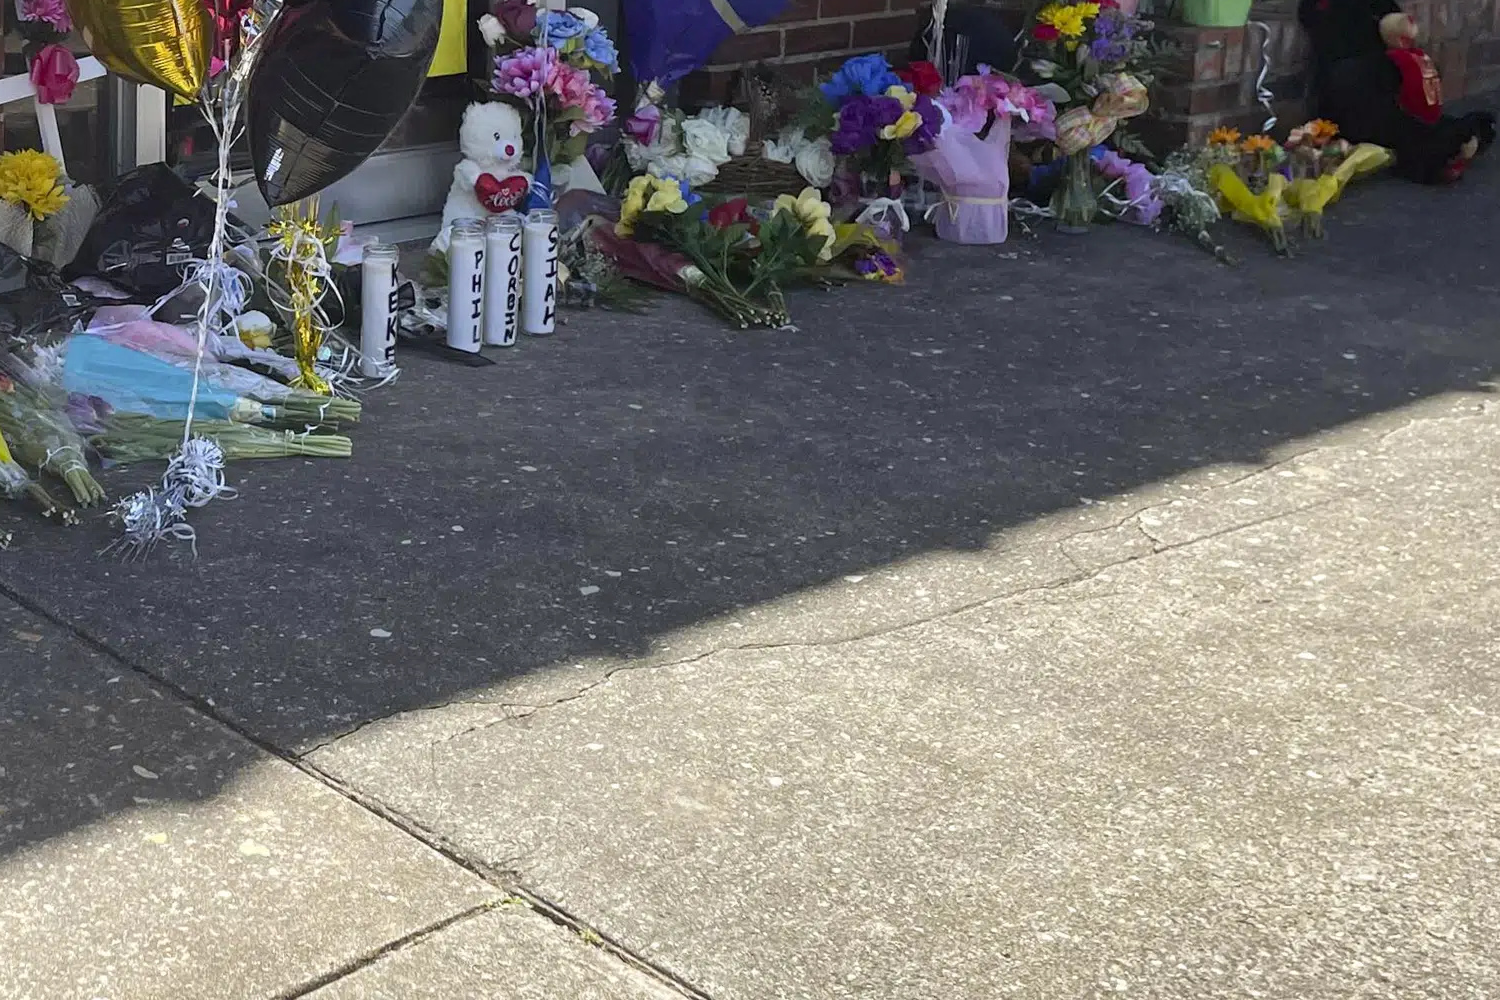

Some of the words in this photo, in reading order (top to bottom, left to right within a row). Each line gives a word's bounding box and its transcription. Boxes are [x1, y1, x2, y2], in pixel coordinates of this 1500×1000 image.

[384, 262, 400, 368] KEKE
[470, 250, 484, 344] PHIL
[503, 232, 521, 343] CORBIN
[542, 226, 559, 326] SIAH
